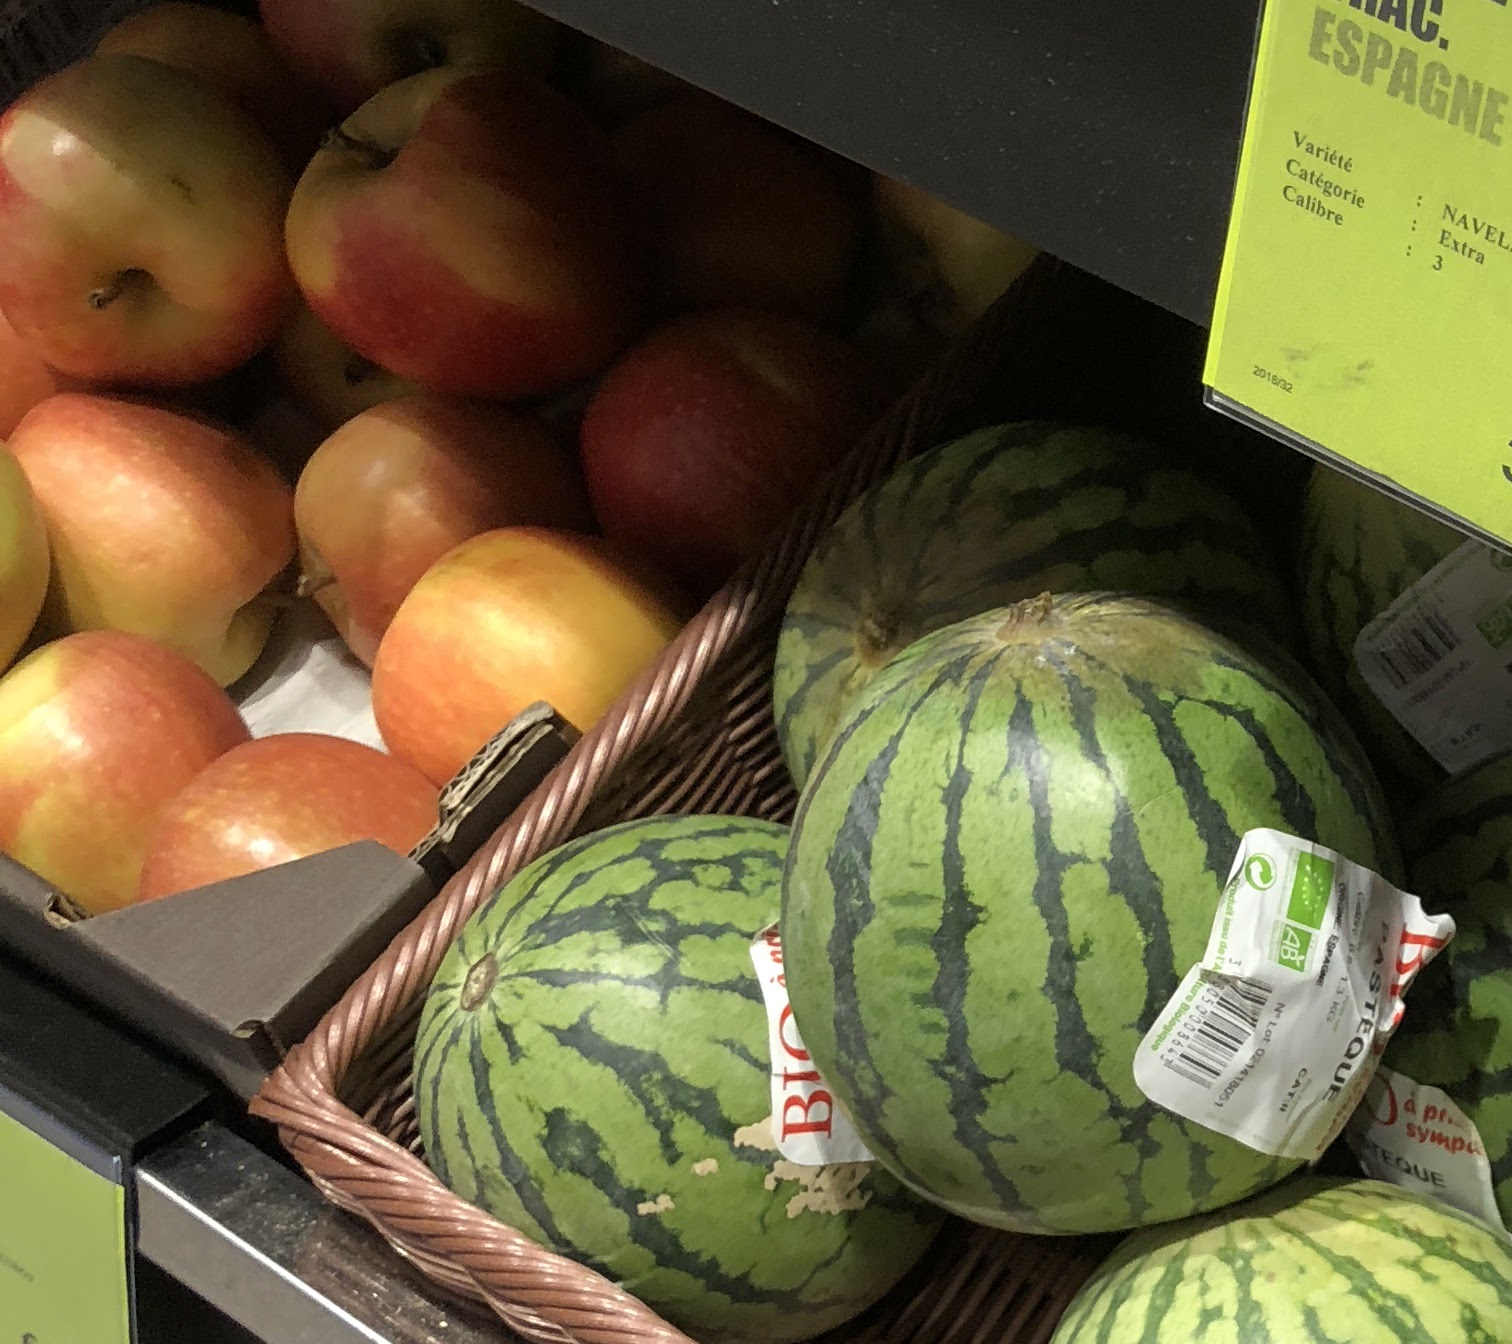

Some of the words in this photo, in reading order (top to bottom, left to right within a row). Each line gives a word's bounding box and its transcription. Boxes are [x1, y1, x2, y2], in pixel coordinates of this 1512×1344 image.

[1307, 7, 1510, 145] ESPAGNE
[1293, 130, 1353, 173] Variété
[1282, 186, 1344, 225] Calibre
[1432, 255, 1444, 271] 3
[1285, 159, 1366, 209] Catégorie
[1439, 229, 1485, 265] Extra
[1252, 364, 1294, 394] 2018/32
[1315, 935, 1339, 988] ESPAGNE
